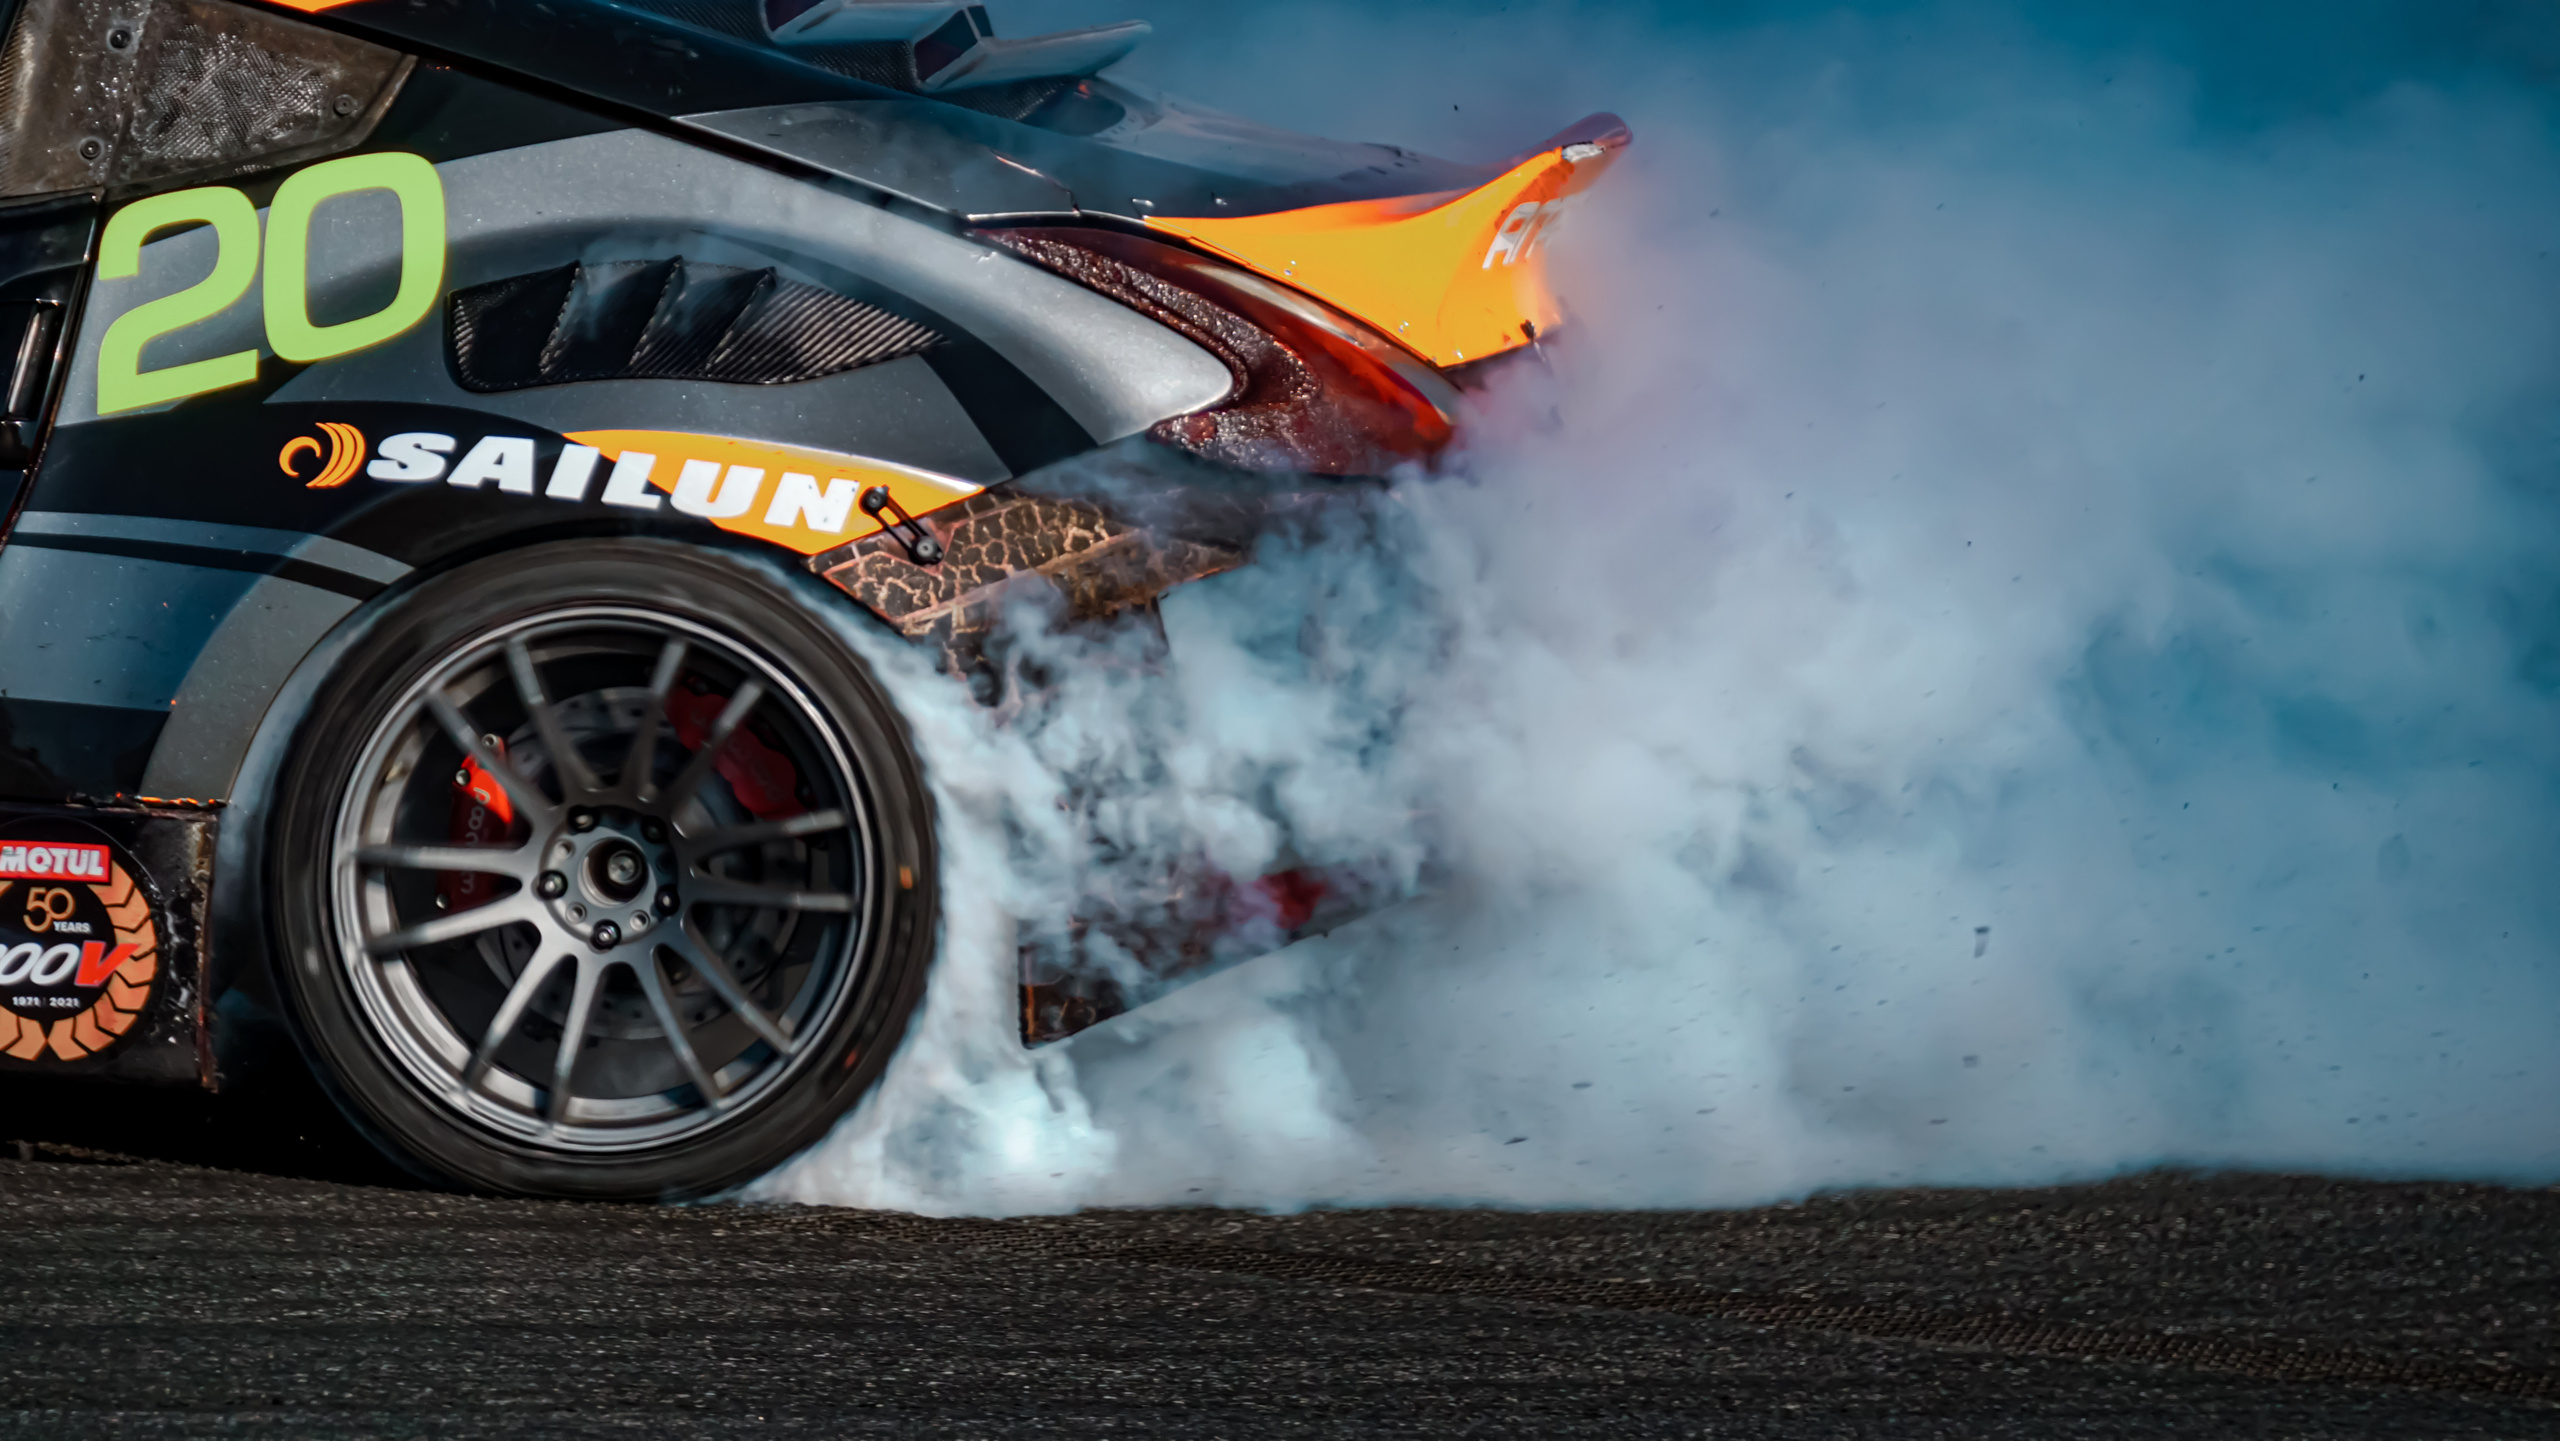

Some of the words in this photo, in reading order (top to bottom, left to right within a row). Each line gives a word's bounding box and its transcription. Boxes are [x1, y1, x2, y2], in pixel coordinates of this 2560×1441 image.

[97, 151, 446, 416] 20
[366, 431, 860, 534] SAILUN
[0, 845, 104, 877] MOTUL
[22, 886, 75, 933] 50
[53, 920, 92, 934] YEARS
[0, 940, 141, 987] 00V
[12, 996, 41, 1007] 1971
[49, 997, 80, 1008] 2021
